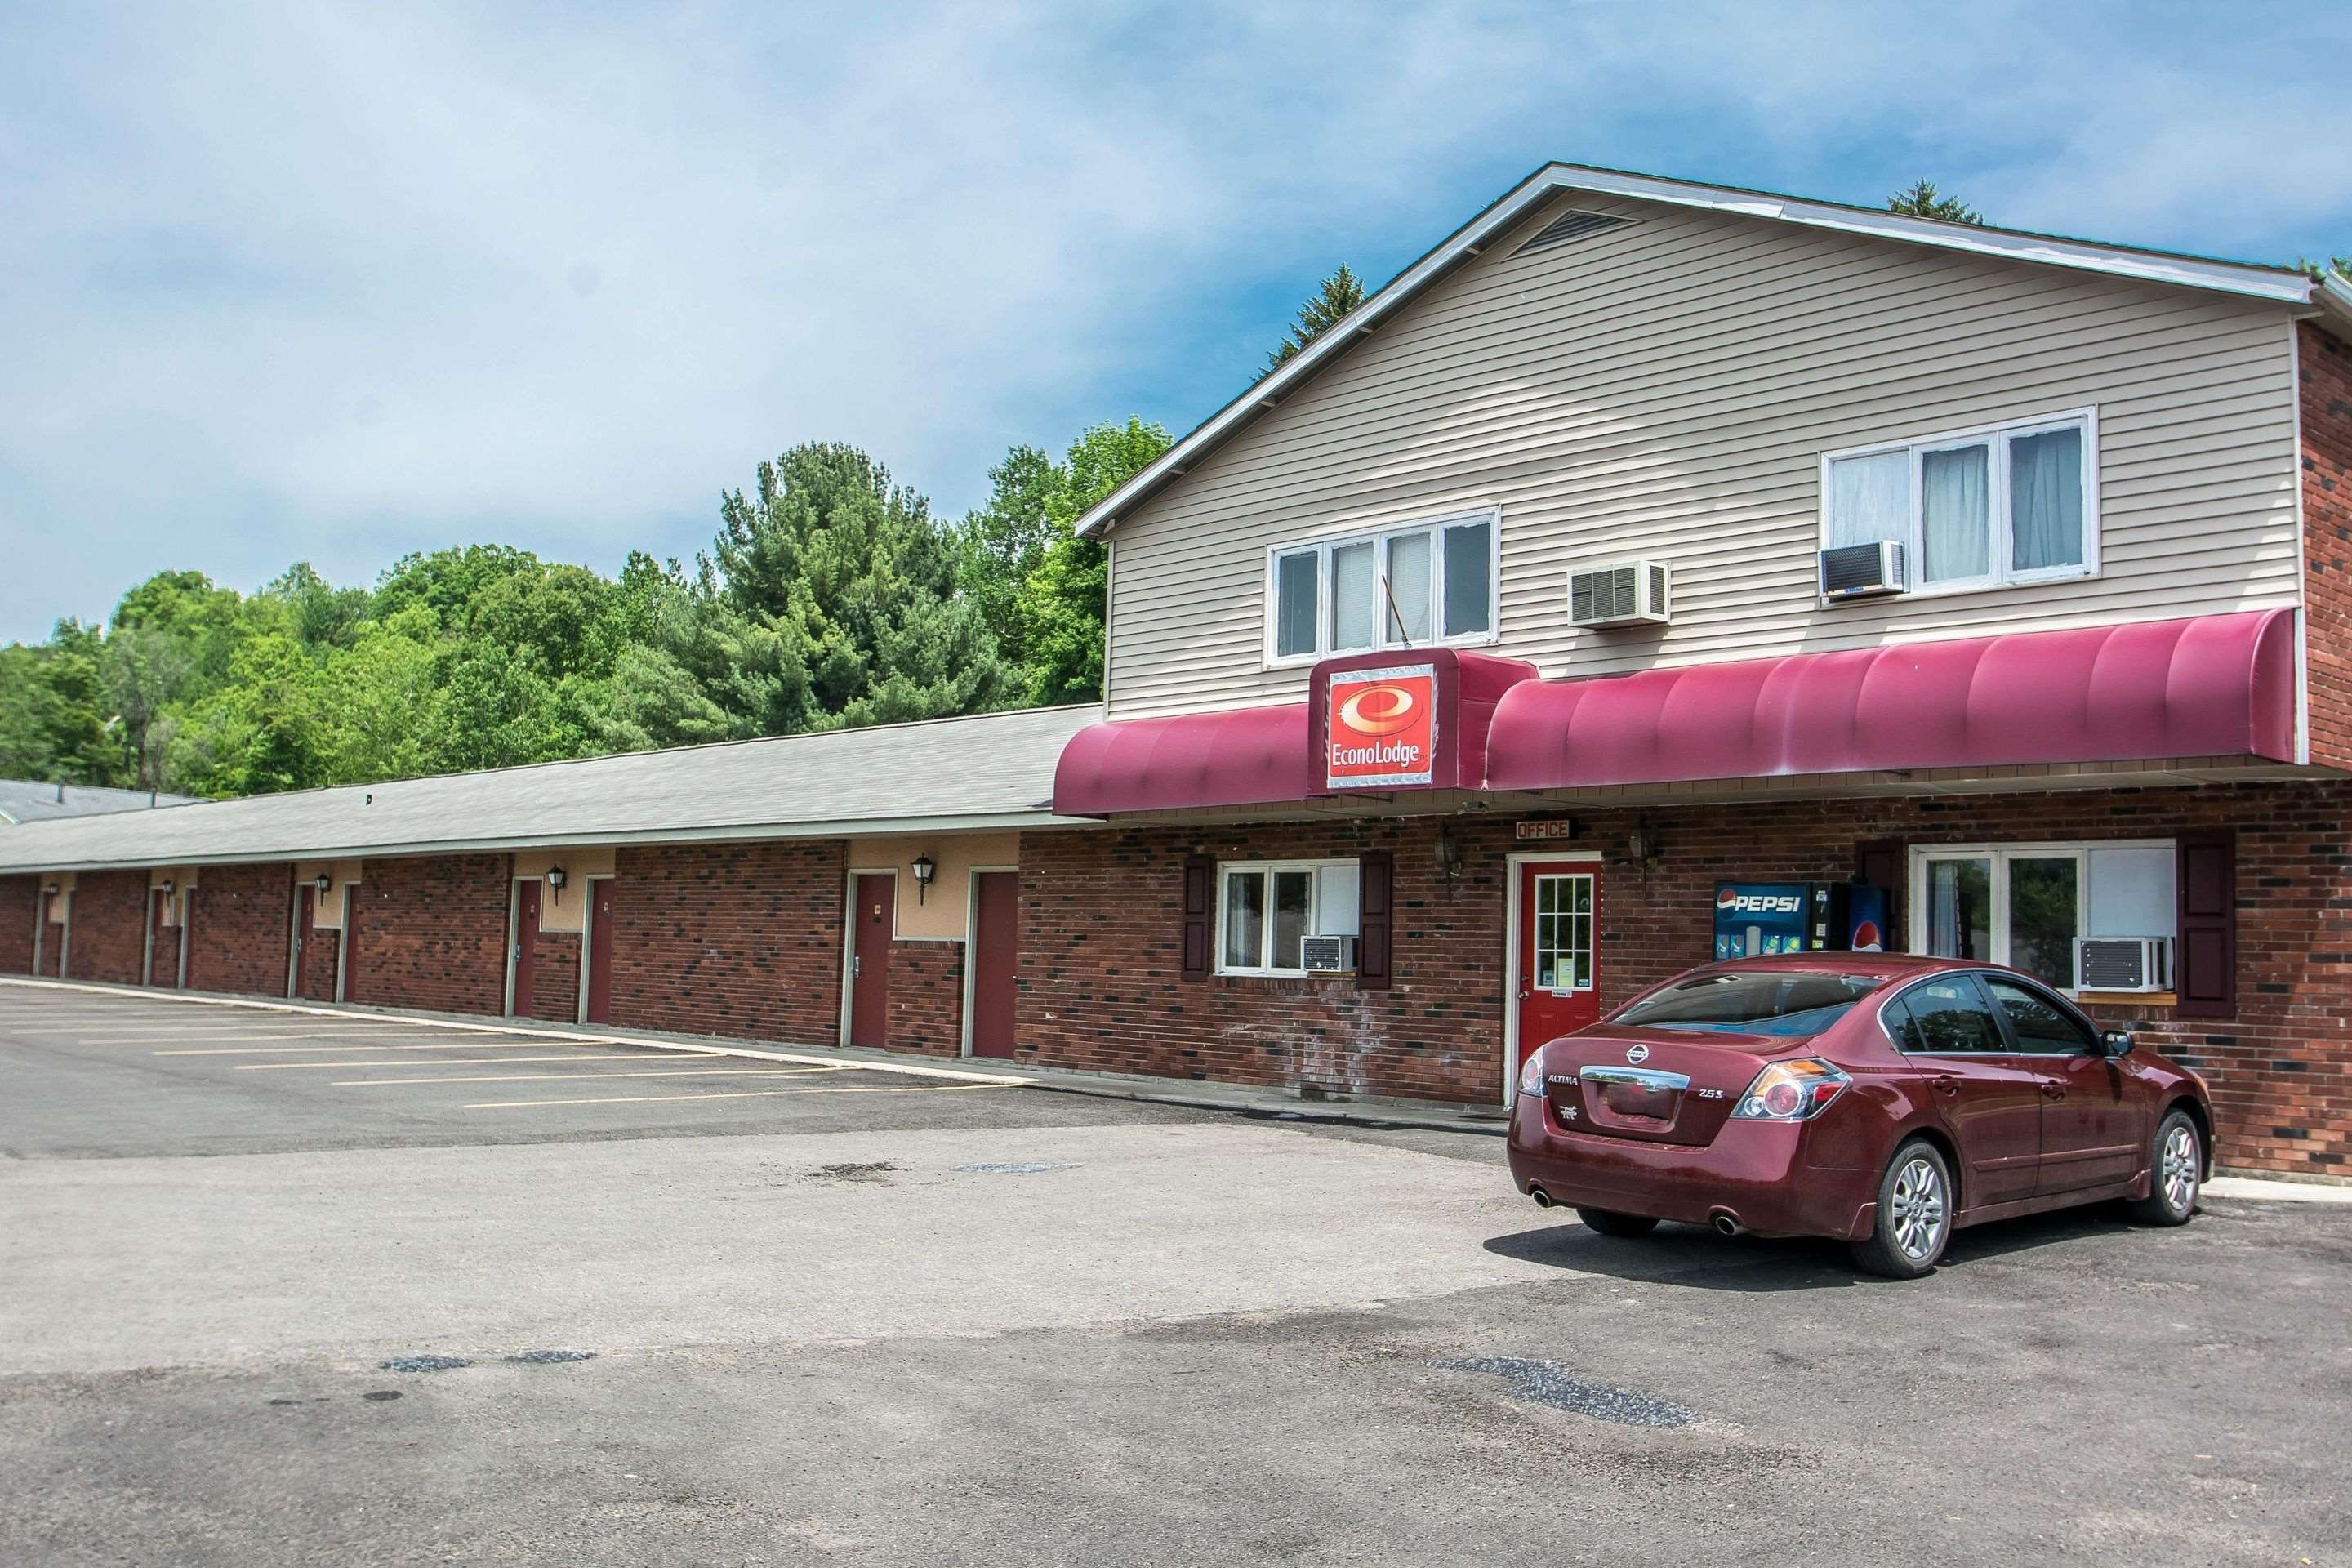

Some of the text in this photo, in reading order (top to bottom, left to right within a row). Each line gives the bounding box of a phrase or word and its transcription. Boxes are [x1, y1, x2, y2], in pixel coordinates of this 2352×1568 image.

[1332, 740, 1419, 767] EconoLodge
[1518, 822, 1568, 838] OFFICE
[1735, 896, 1801, 912] PEPSI
[1548, 1074, 1578, 1085] ALTIMA
